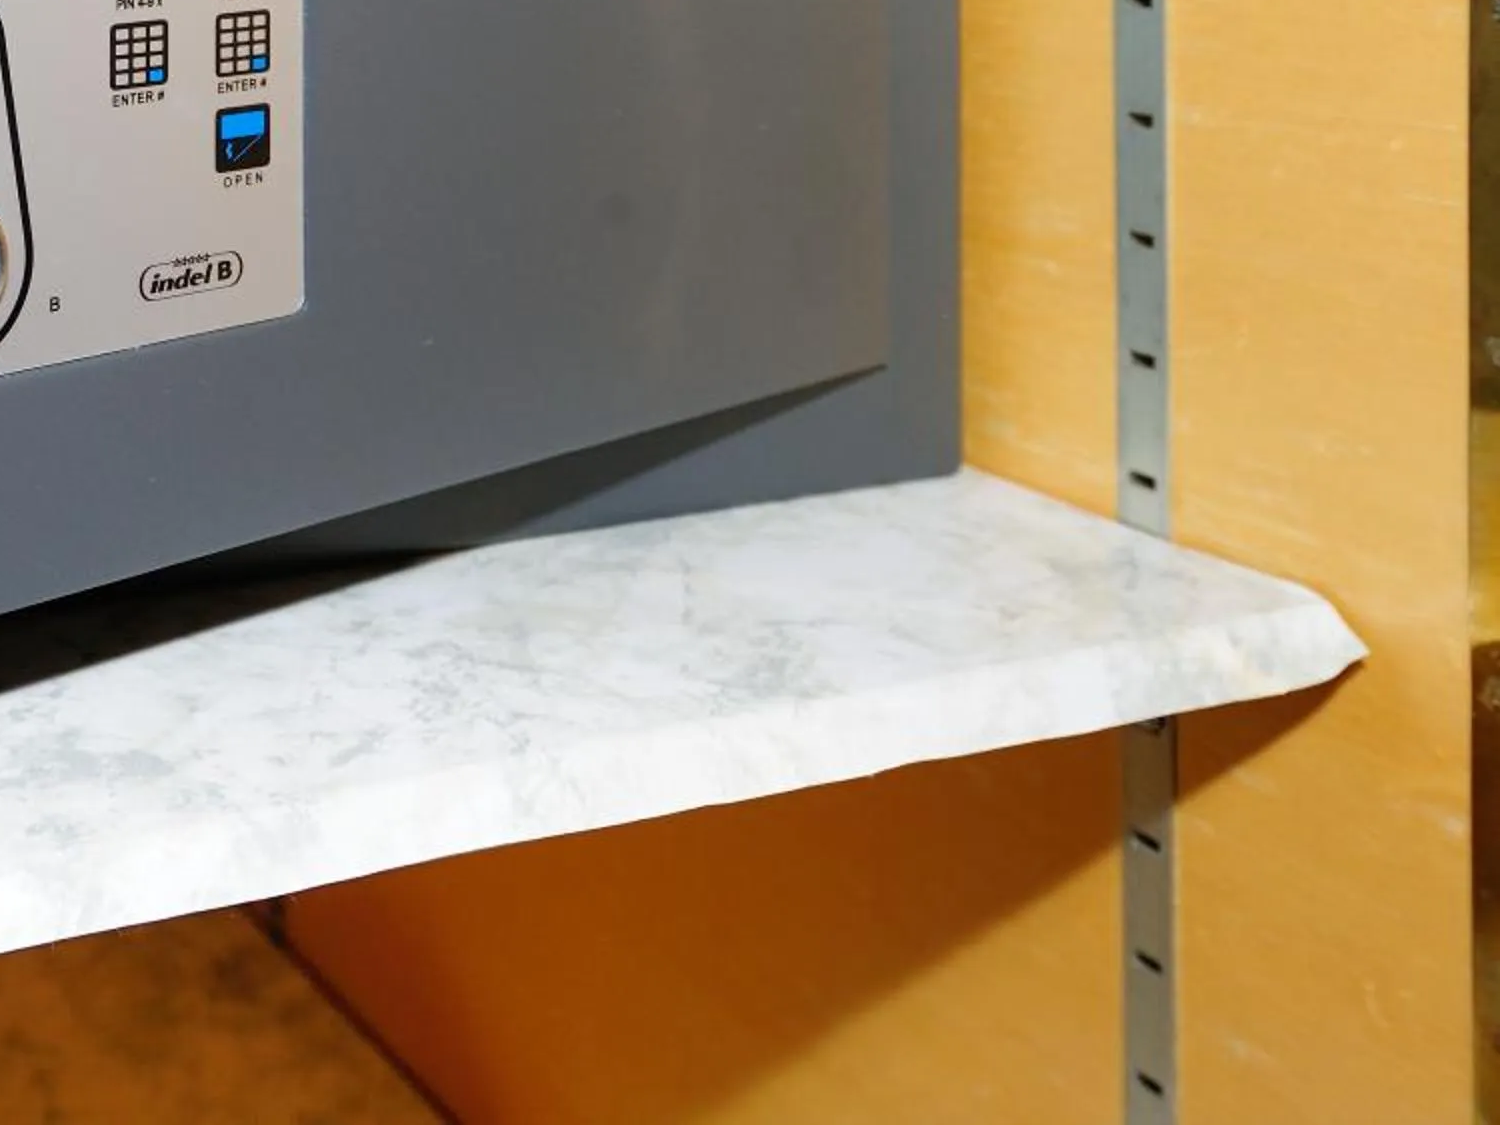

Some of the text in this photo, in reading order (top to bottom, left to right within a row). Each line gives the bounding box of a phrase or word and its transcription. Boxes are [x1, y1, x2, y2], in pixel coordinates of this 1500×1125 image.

[217, 79, 258, 94] ENTER
[112, 91, 155, 108] ENTER
[223, 172, 264, 188] OPEN
[150, 260, 233, 294] indel B
[49, 297, 61, 312] B
